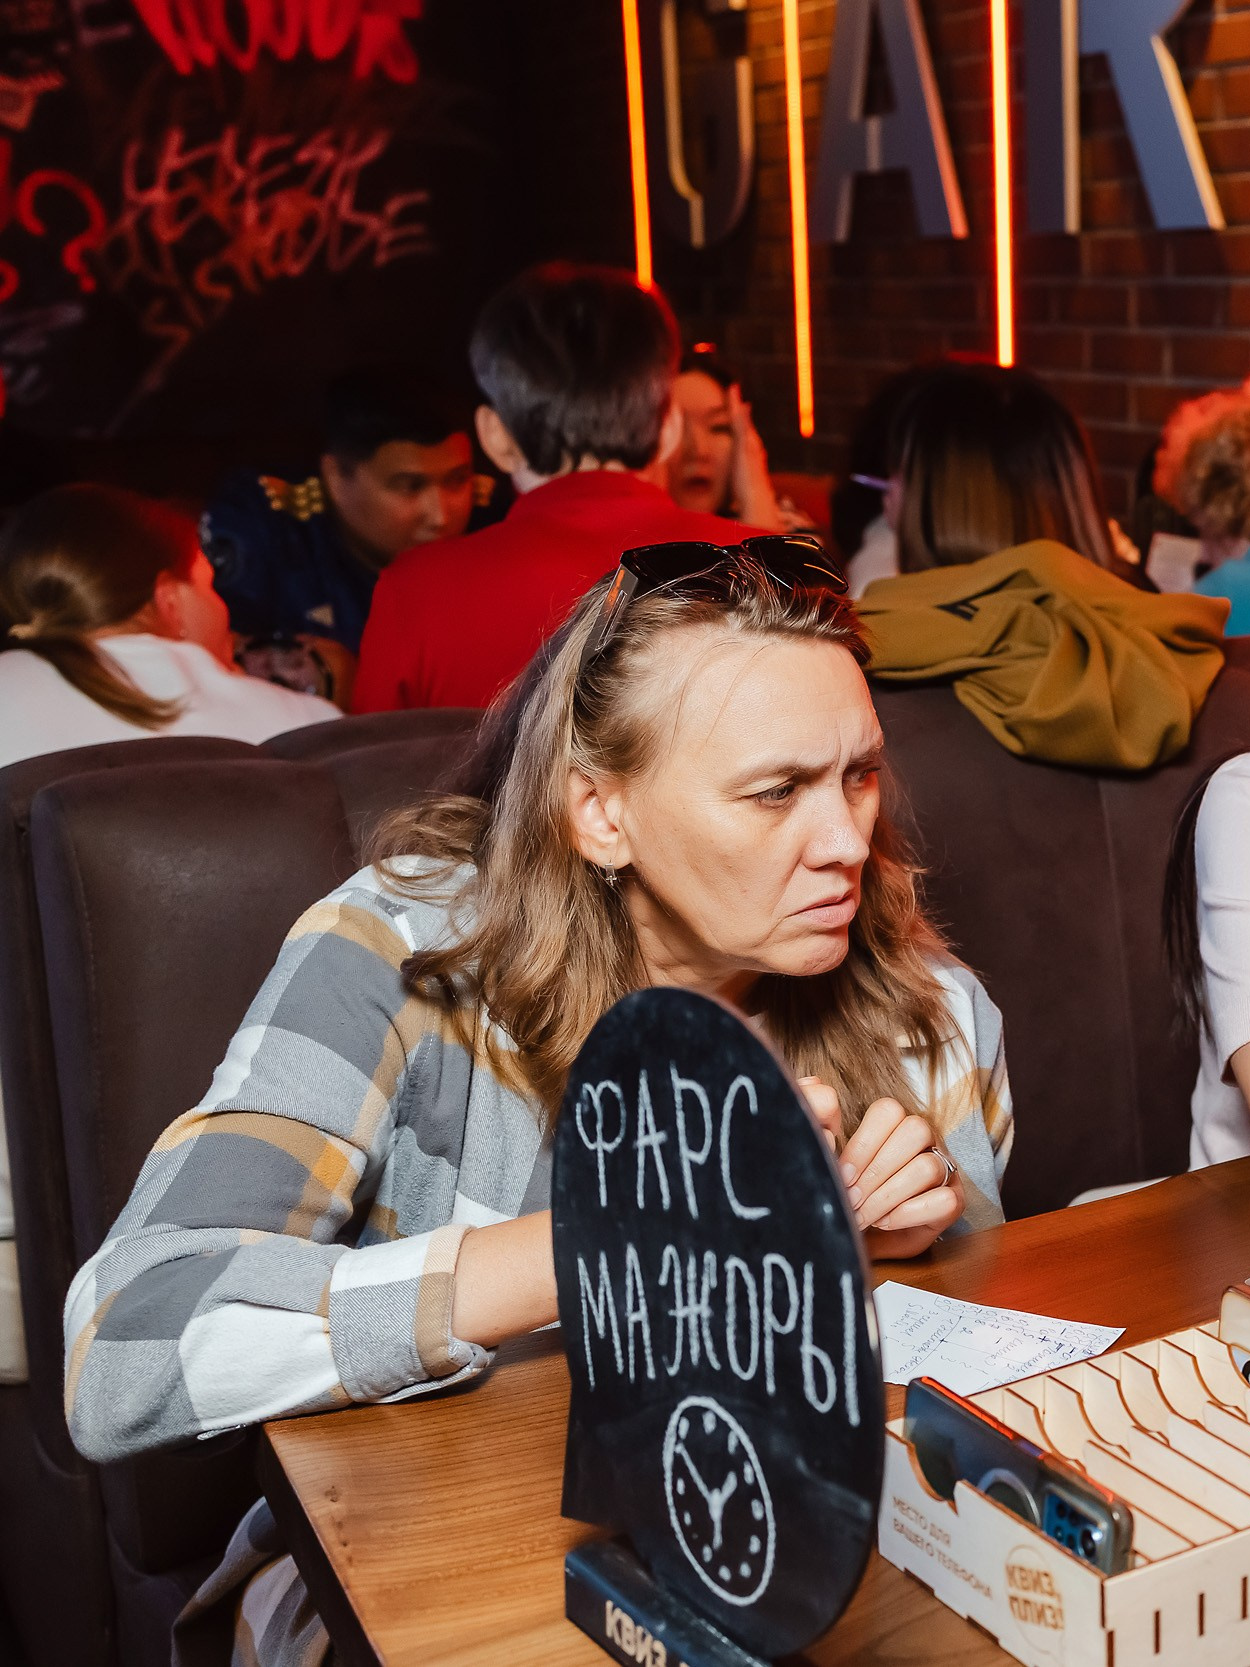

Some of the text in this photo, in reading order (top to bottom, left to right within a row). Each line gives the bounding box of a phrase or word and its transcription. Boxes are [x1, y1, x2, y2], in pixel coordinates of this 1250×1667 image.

[575, 1059, 770, 1220] ФАРС
[577, 1244, 859, 1427] МАЖОРЫ
[893, 1496, 951, 1546] МЕСТО ДЛЯ
[893, 1518, 994, 1599] ВАШЕГО ТЕЛЕФОНА
